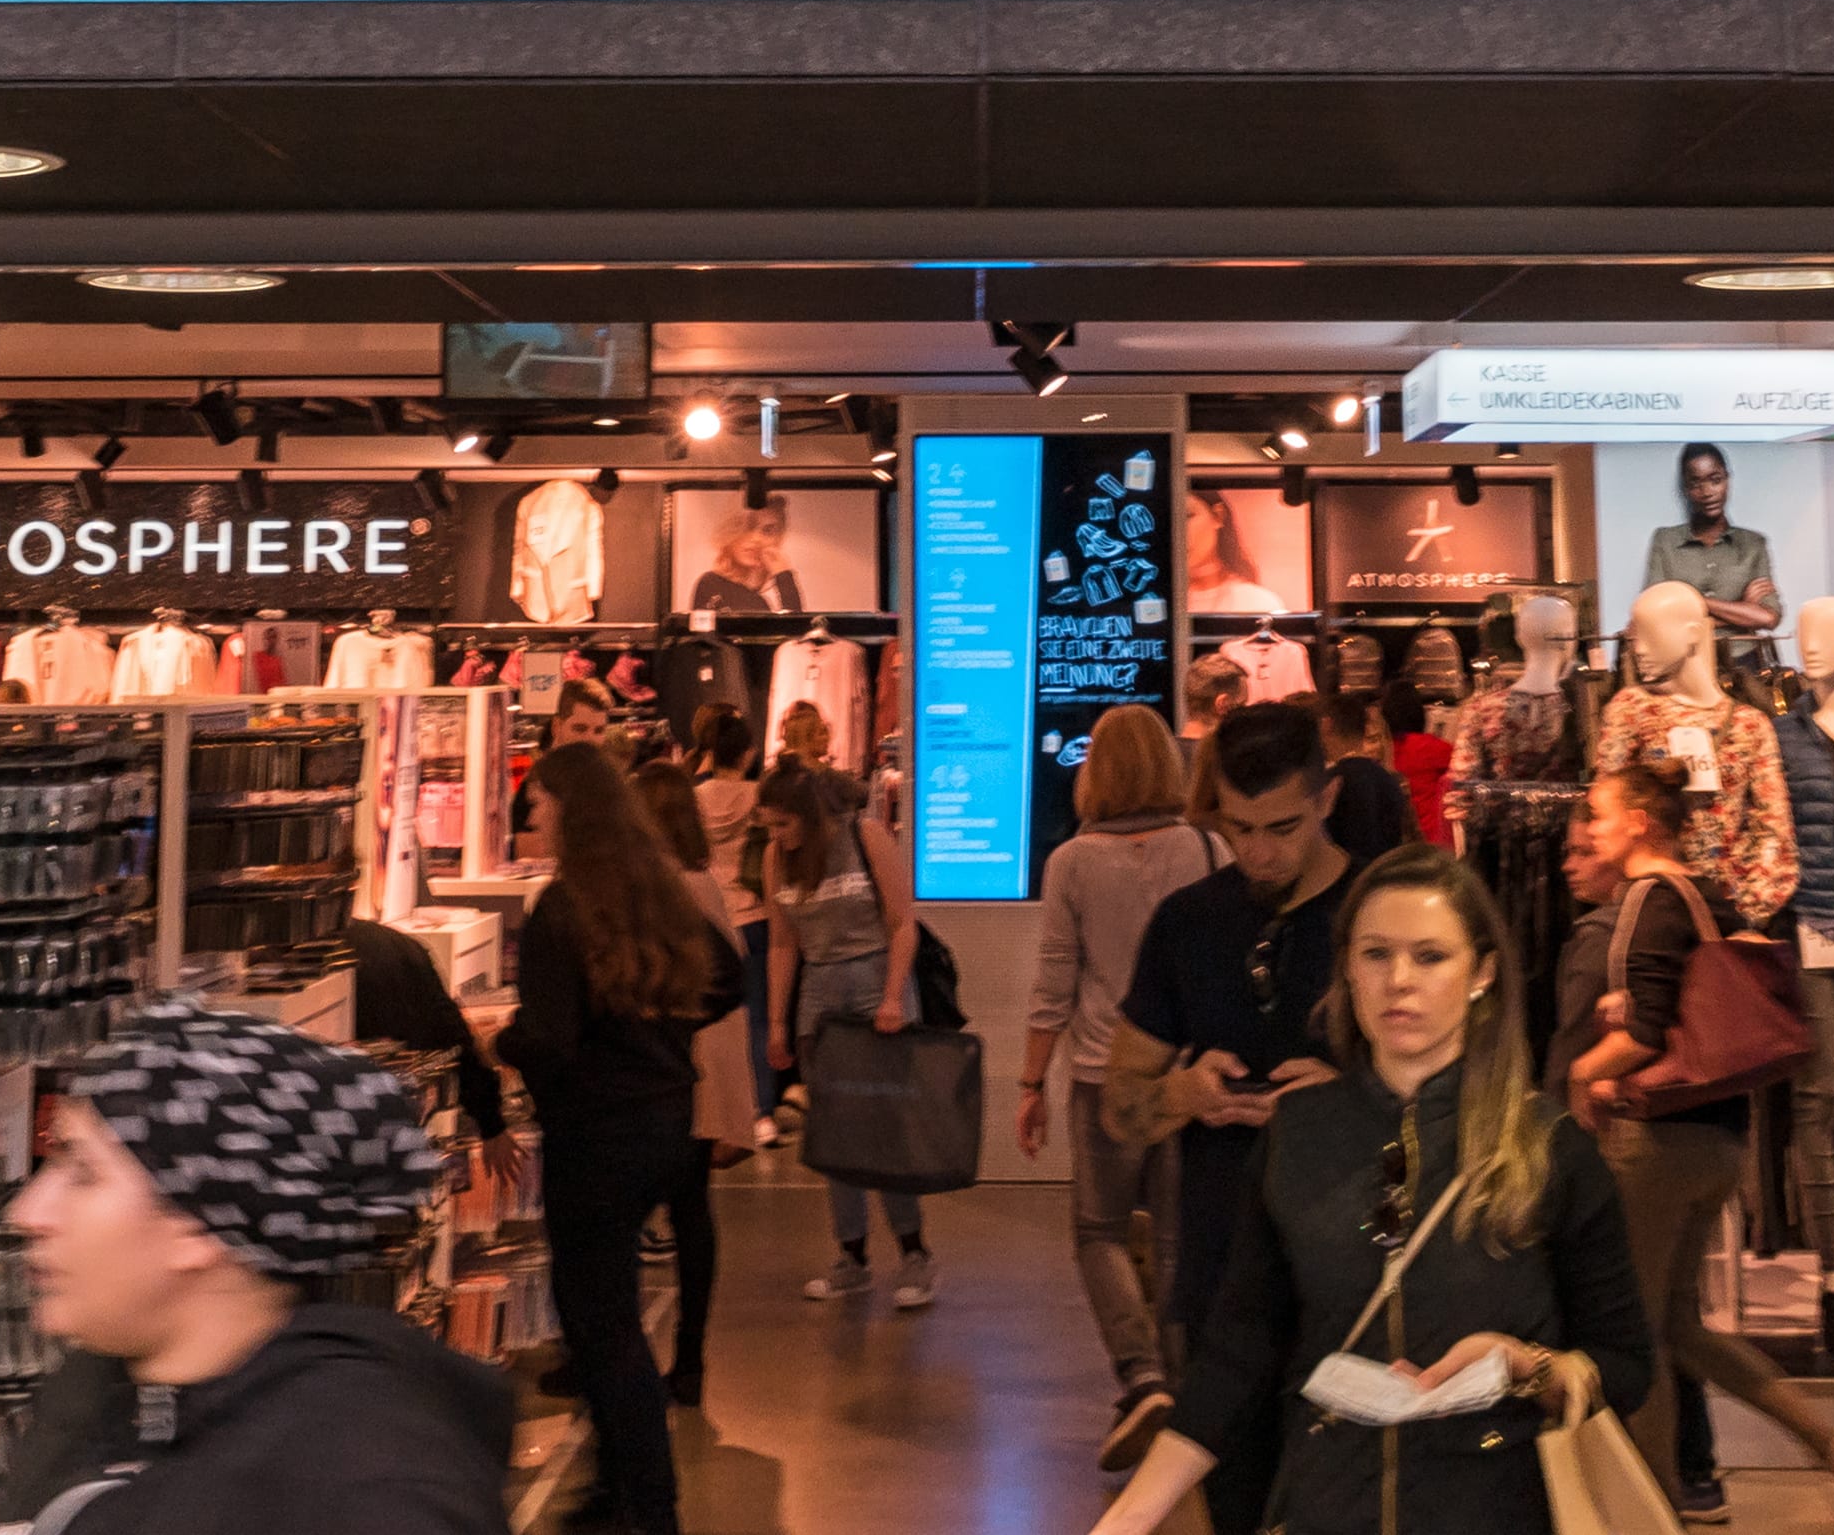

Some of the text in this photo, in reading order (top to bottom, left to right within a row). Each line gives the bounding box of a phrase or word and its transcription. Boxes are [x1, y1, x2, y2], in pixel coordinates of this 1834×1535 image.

[1479, 365, 1548, 383] KASSE
[1480, 391, 1683, 410] UMKLEIDEKABINEN
[1732, 388, 1834, 410] AUFZÜGE
